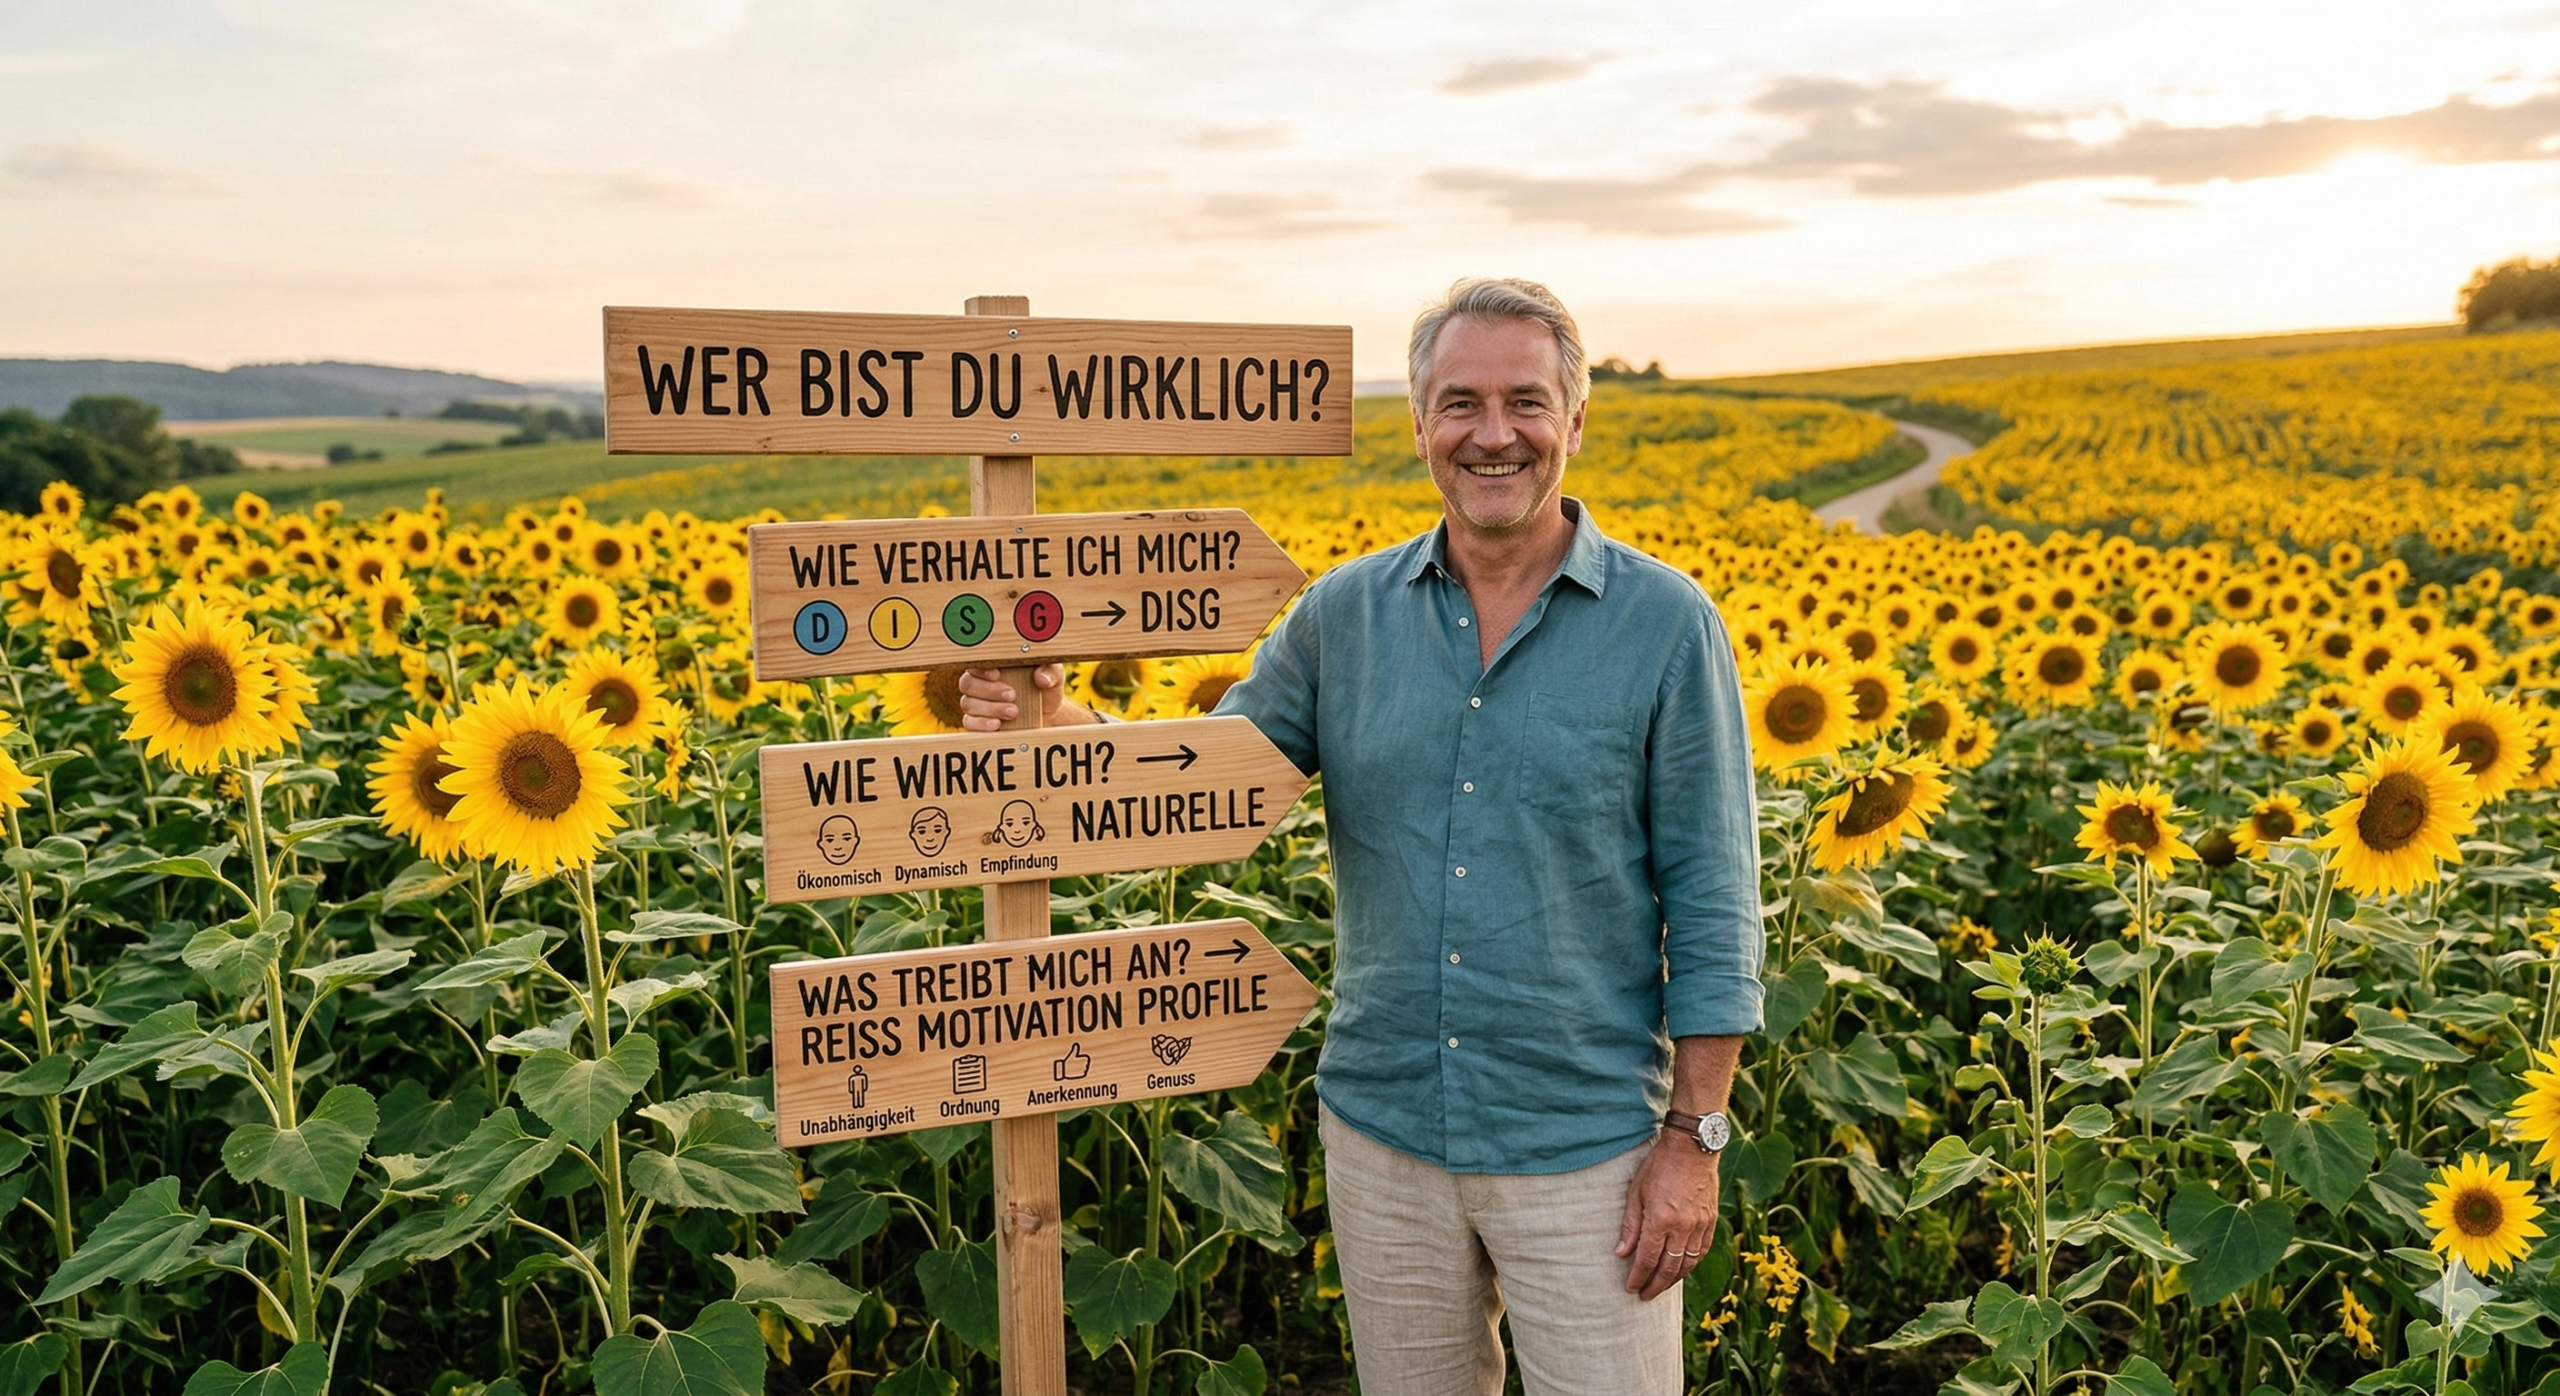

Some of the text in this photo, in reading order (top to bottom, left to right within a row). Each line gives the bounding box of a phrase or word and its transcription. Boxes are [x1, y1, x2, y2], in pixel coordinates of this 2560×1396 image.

[637, 344, 1330, 423] WER BIST DU WIRKLICH?
[788, 530, 1241, 589] WIE VERHALTE ICH MICH?
[811, 587, 1220, 644] D I S G DISG
[803, 740, 1115, 807] WIE WIRKE ICH?
[1072, 787, 1266, 843] NATURELLE
[797, 853, 1058, 890] Ökonomisch Dynamisch Empfindung
[797, 938, 1191, 1018] WAS TREIBT MICH AN?
[801, 973, 1269, 1066] REISS MOTIVATION PROFILE
[800, 1072, 1196, 1136] Unabhängigkeit Ordnung Anerkennung Genuss
